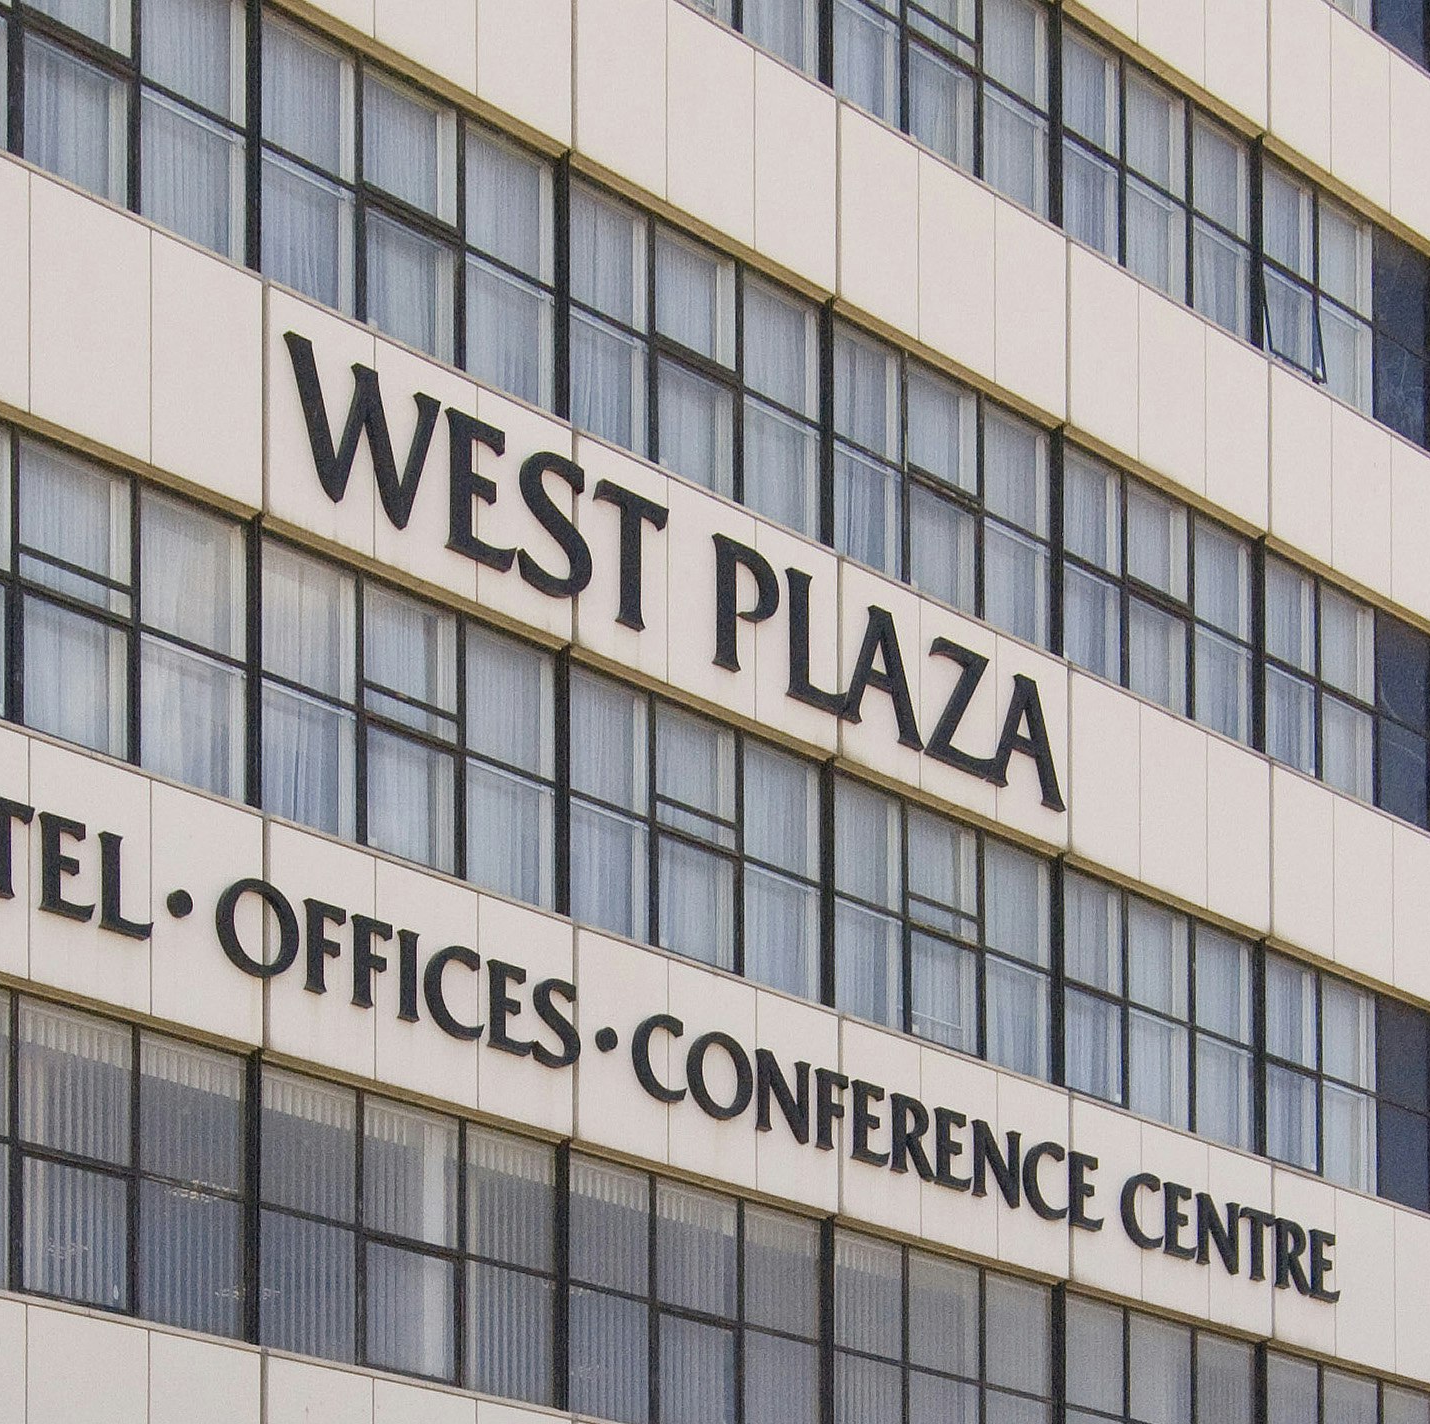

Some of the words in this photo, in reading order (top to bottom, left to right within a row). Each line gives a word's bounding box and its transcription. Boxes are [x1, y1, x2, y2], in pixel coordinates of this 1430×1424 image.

[283, 331, 669, 632] WEST
[711, 533, 1065, 812] PLAZA
[215, 878, 581, 1068] OFFICES
[631, 1013, 1104, 1231] CONFERENCE
[1120, 1172, 1340, 1302] CENTRE
